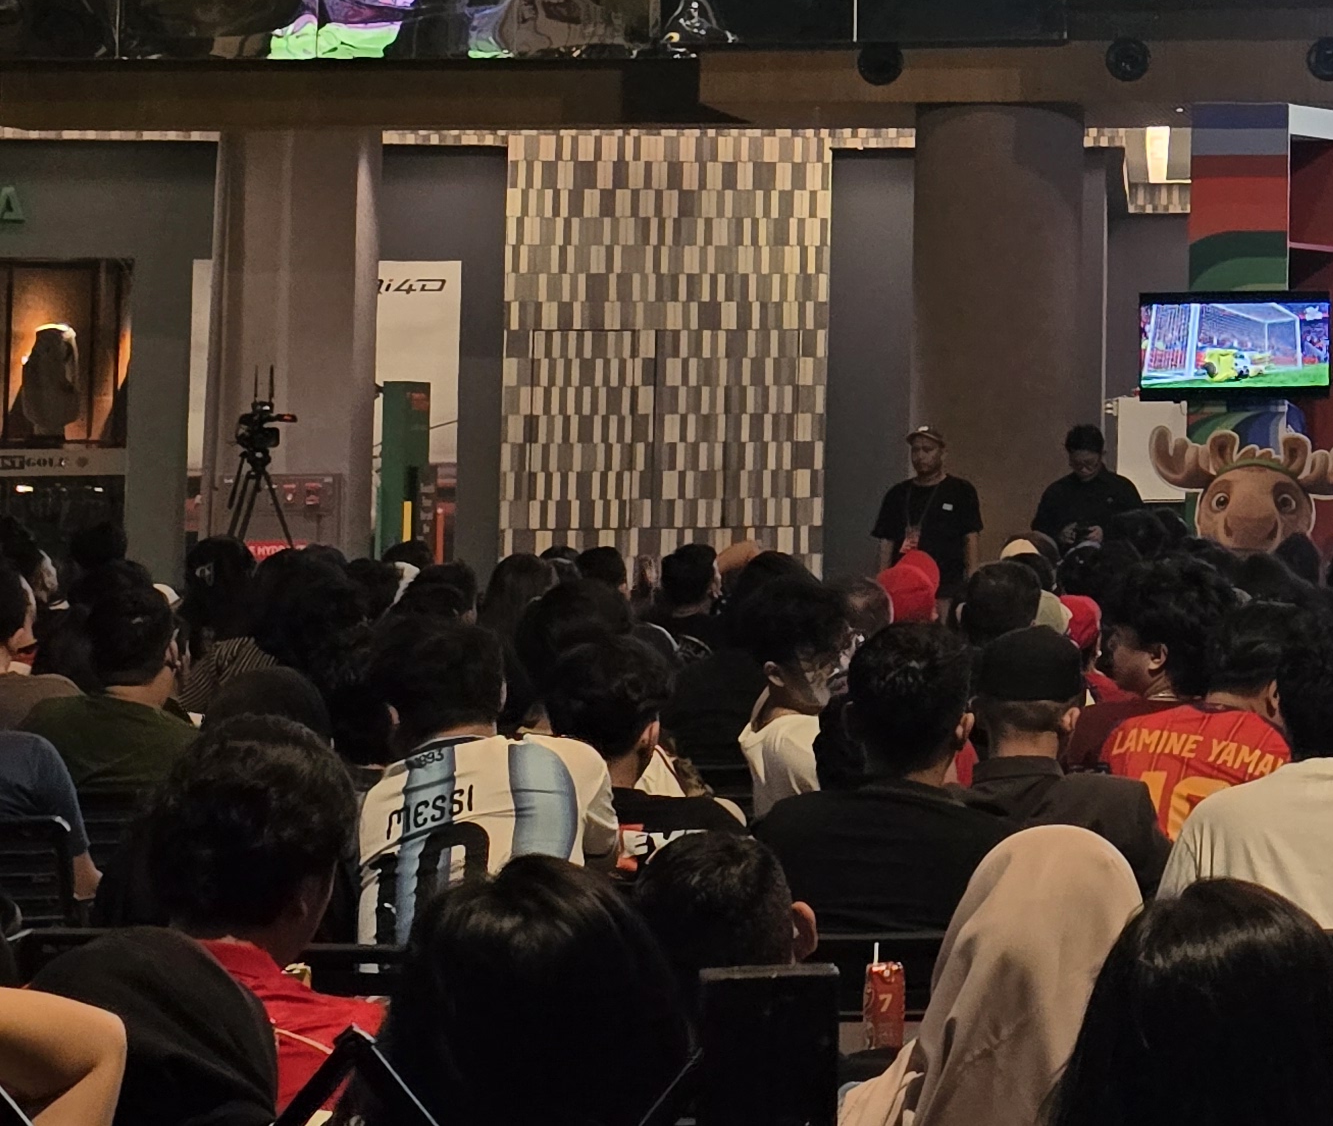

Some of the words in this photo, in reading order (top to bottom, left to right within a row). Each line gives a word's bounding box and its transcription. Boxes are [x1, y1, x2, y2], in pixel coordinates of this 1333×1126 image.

[1111, 727, 1203, 759] LAMINE
[386, 784, 474, 840] MESSI
[878, 993, 893, 1013] 7
